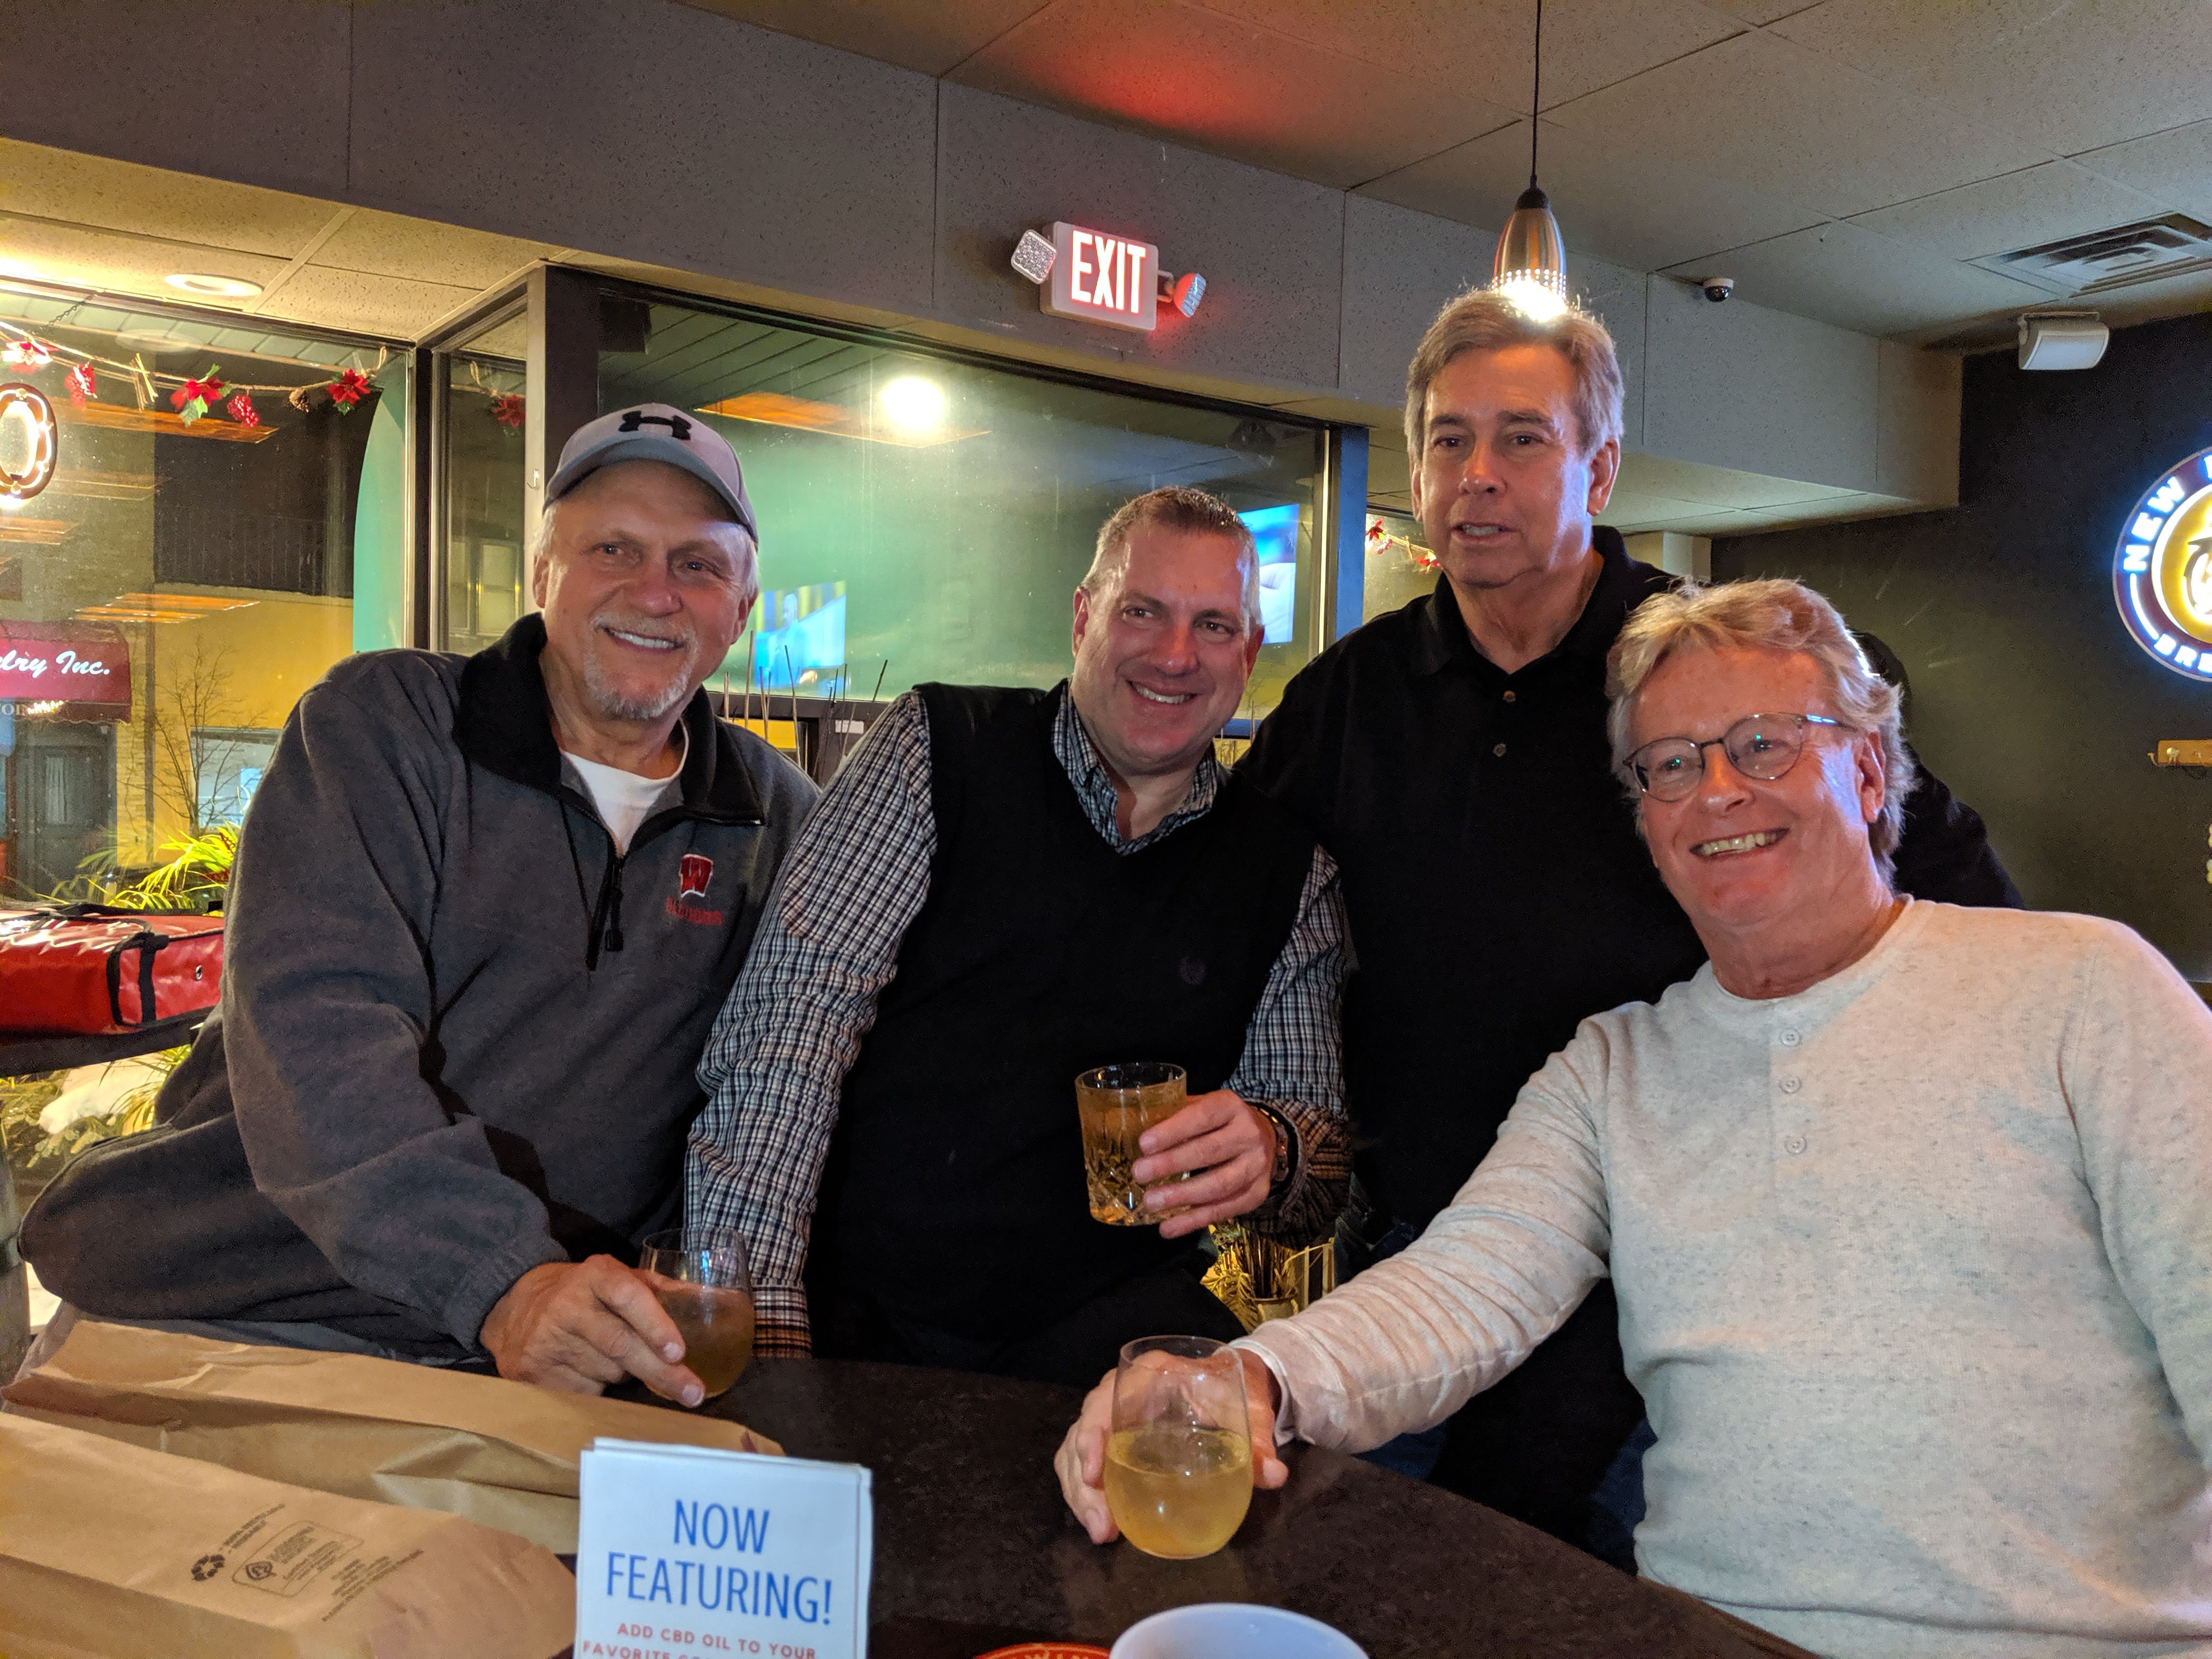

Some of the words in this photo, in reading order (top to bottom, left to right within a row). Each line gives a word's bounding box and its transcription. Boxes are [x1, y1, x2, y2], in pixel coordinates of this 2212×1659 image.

[1071, 229, 1147, 314] EXIT
[2123, 476, 2185, 572] NEW
[0, 649, 48, 679] lry
[55, 650, 110, 675] Inc.
[673, 1498, 770, 1554] NOW
[606, 1550, 833, 1626] FEATURING!
[582, 1640, 672, 1659] FAVORITE
[617, 1622, 654, 1640] ADD
[660, 1627, 696, 1645] CBD
[702, 1633, 731, 1651] OIL
[738, 1638, 761, 1654] TO
[769, 1642, 816, 1659] YOUR
